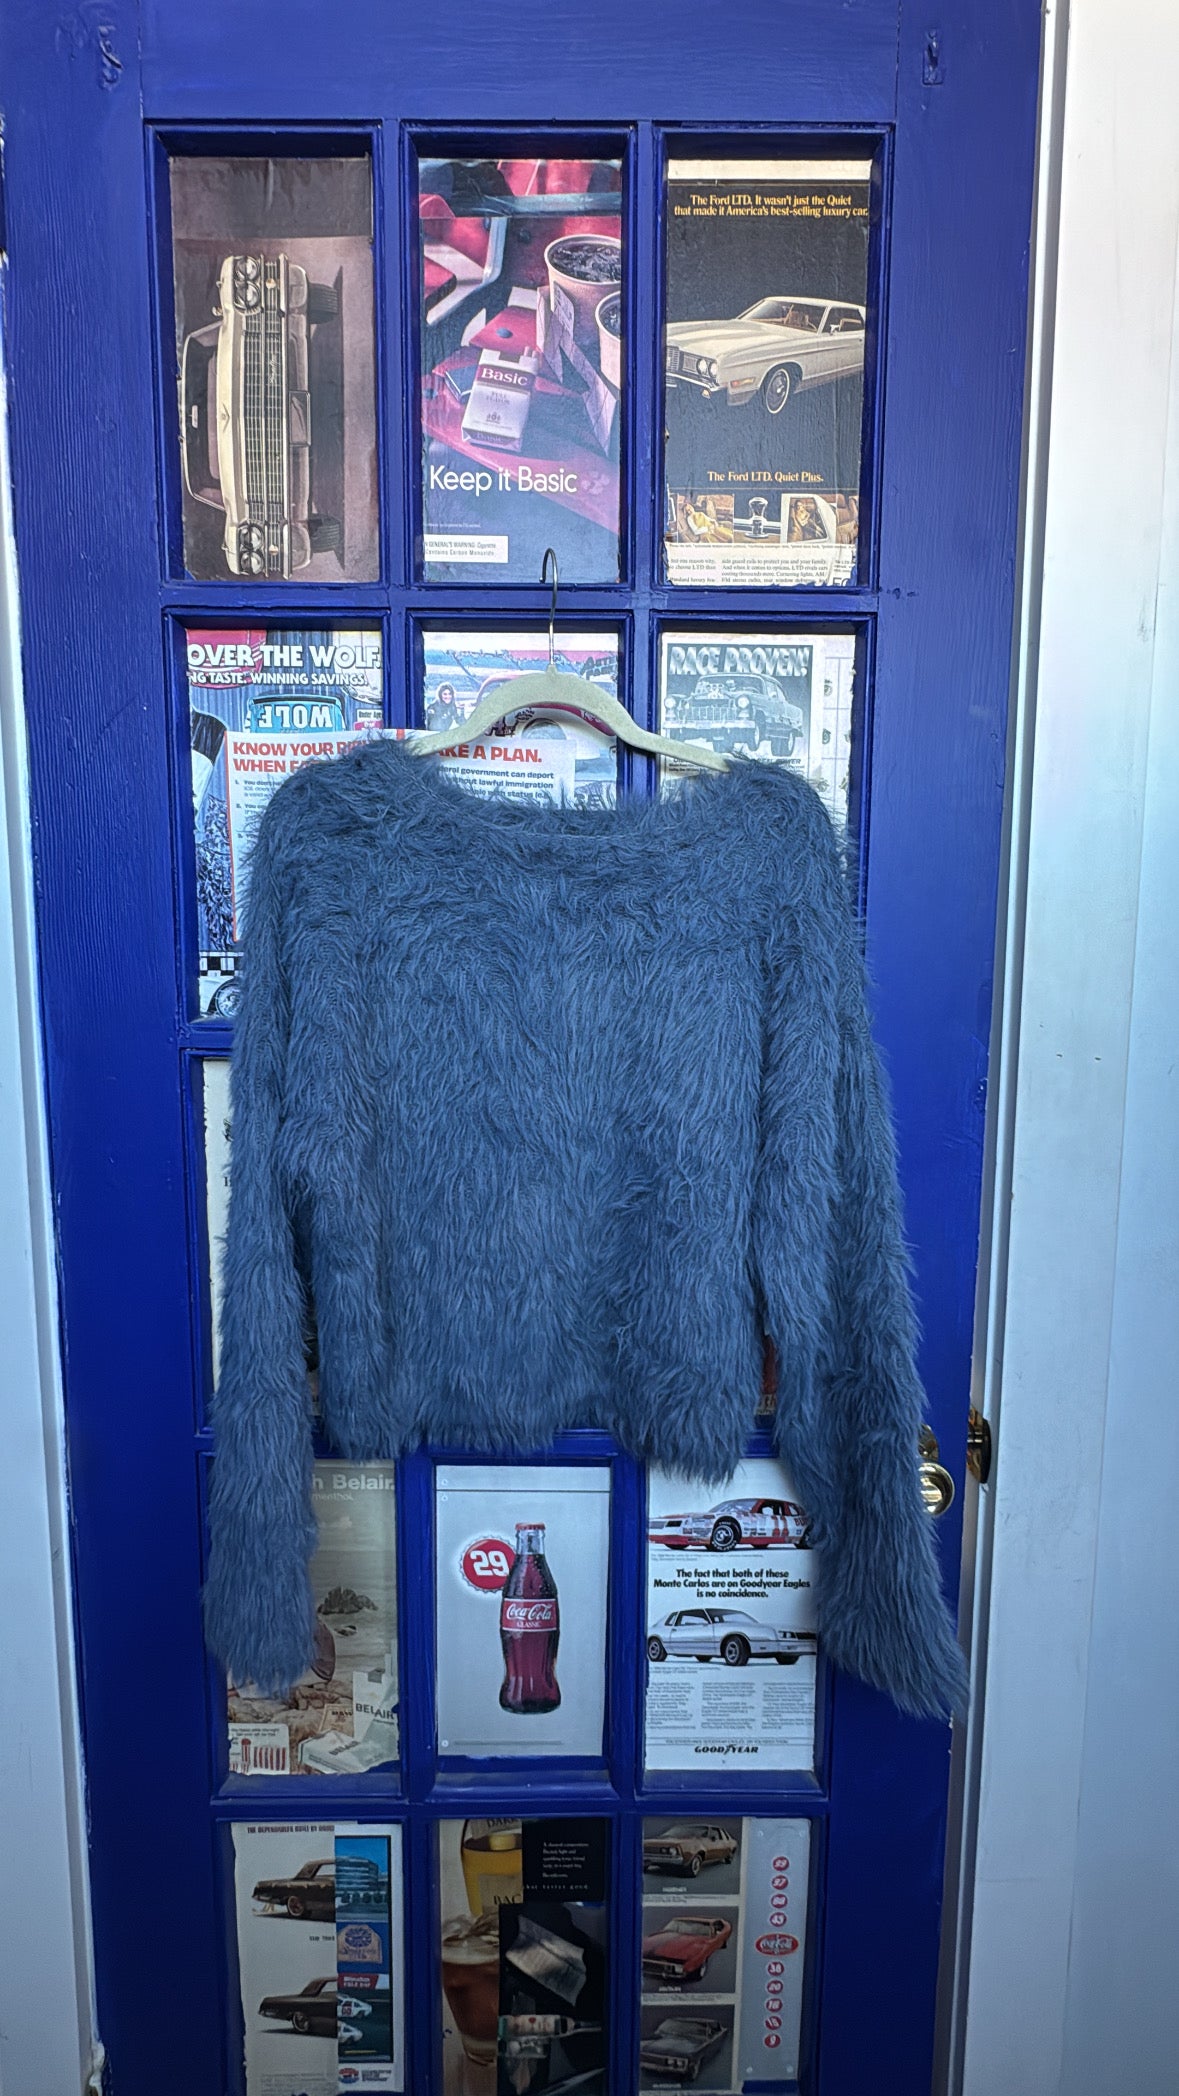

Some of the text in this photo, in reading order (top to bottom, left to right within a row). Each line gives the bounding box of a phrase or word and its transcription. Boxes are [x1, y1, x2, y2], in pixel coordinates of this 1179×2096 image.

[690, 194, 851, 207] The Ford LTD. It wasn't just the Quiet
[674, 206, 868, 219] that made it America's best-selling luxury car.
[481, 368, 528, 386] Basic
[430, 465, 577, 496] Keep it Basic
[707, 471, 824, 483] The Ford LTD. Quiet Plus.
[187, 644, 254, 668] OVER
[261, 645, 303, 668] THE
[669, 646, 810, 677] RACE PROVEN!
[208, 672, 247, 684] TASTE.
[250, 672, 308, 685] WINNING
[311, 673, 369, 686] SAVINGS.
[258, 705, 334, 729] WOLF
[233, 742, 287, 756] KNOW
[290, 742, 334, 756] YOUR
[473, 745, 486, 760] A
[491, 746, 542, 763] PLAN.
[233, 759, 286, 772] WHEN
[461, 767, 509, 777] government
[527, 771, 554, 780] deport
[478, 778, 504, 787] lawful
[505, 780, 554, 790] immigration
[507, 791, 534, 799] status
[332, 1474, 395, 1490] Belair.
[470, 1550, 510, 1577] 29
[676, 1569, 789, 1578] The fact that both of these
[653, 1579, 682, 1588] Monte
[683, 1579, 710, 1588] Carlos
[740, 1579, 782, 1589] Goodyear
[783, 1580, 811, 1590] Eagles
[696, 1589, 704, 1598] is
[718, 1589, 769, 1598] coincidence.
[506, 1603, 553, 1620] Coca-Cola
[355, 1703, 396, 1720] BELAIR
[694, 1744, 759, 1755] GOODYEAR
[769, 2034, 777, 2046] 9
